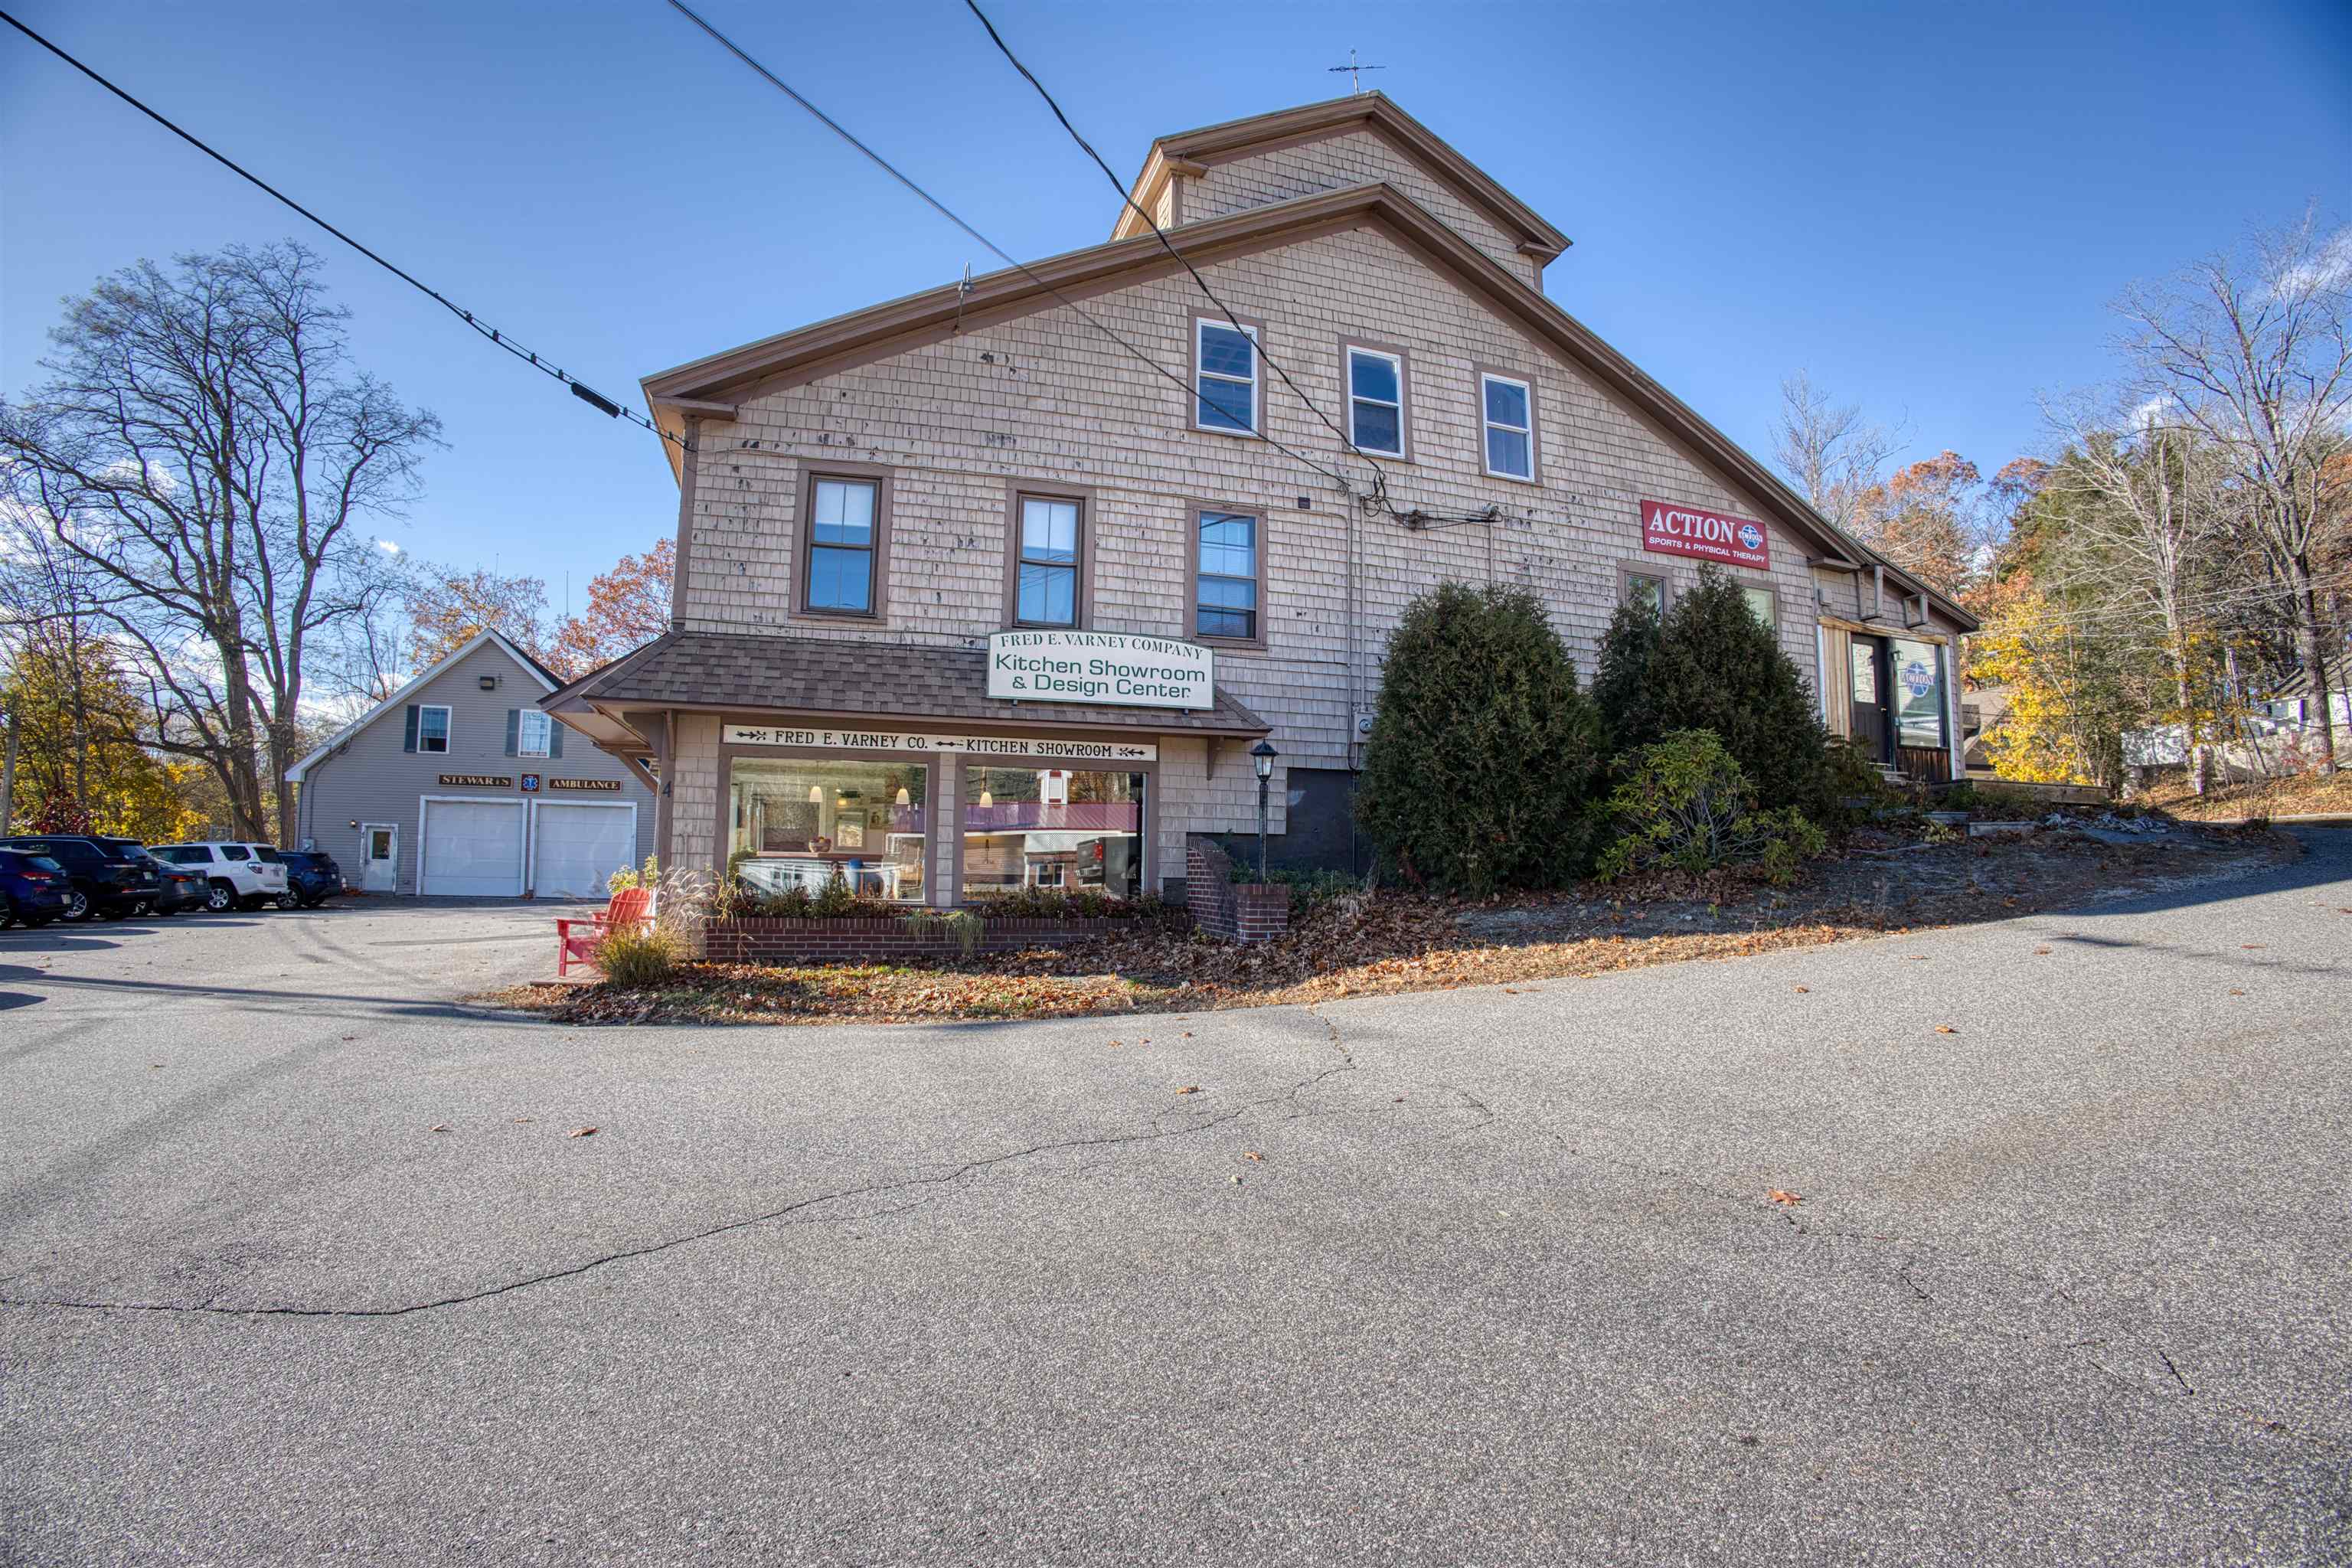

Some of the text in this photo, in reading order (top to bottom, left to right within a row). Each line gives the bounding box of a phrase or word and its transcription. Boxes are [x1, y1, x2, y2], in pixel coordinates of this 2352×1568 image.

[1649, 508, 1735, 544] ACTION
[1648, 536, 1766, 563] SPORTS & PHYSICAL THERAPY
[1001, 633, 1203, 660] FRED E. VARNEY COMPANY
[995, 653, 1205, 682] Kitchen Showroom
[1012, 675, 1027, 690] &
[1034, 674, 1109, 697] Design
[775, 730, 1112, 757] FRED E. VARNEY CO. KITCHEN SHOWROOM
[552, 779, 619, 790] AMBULANCE
